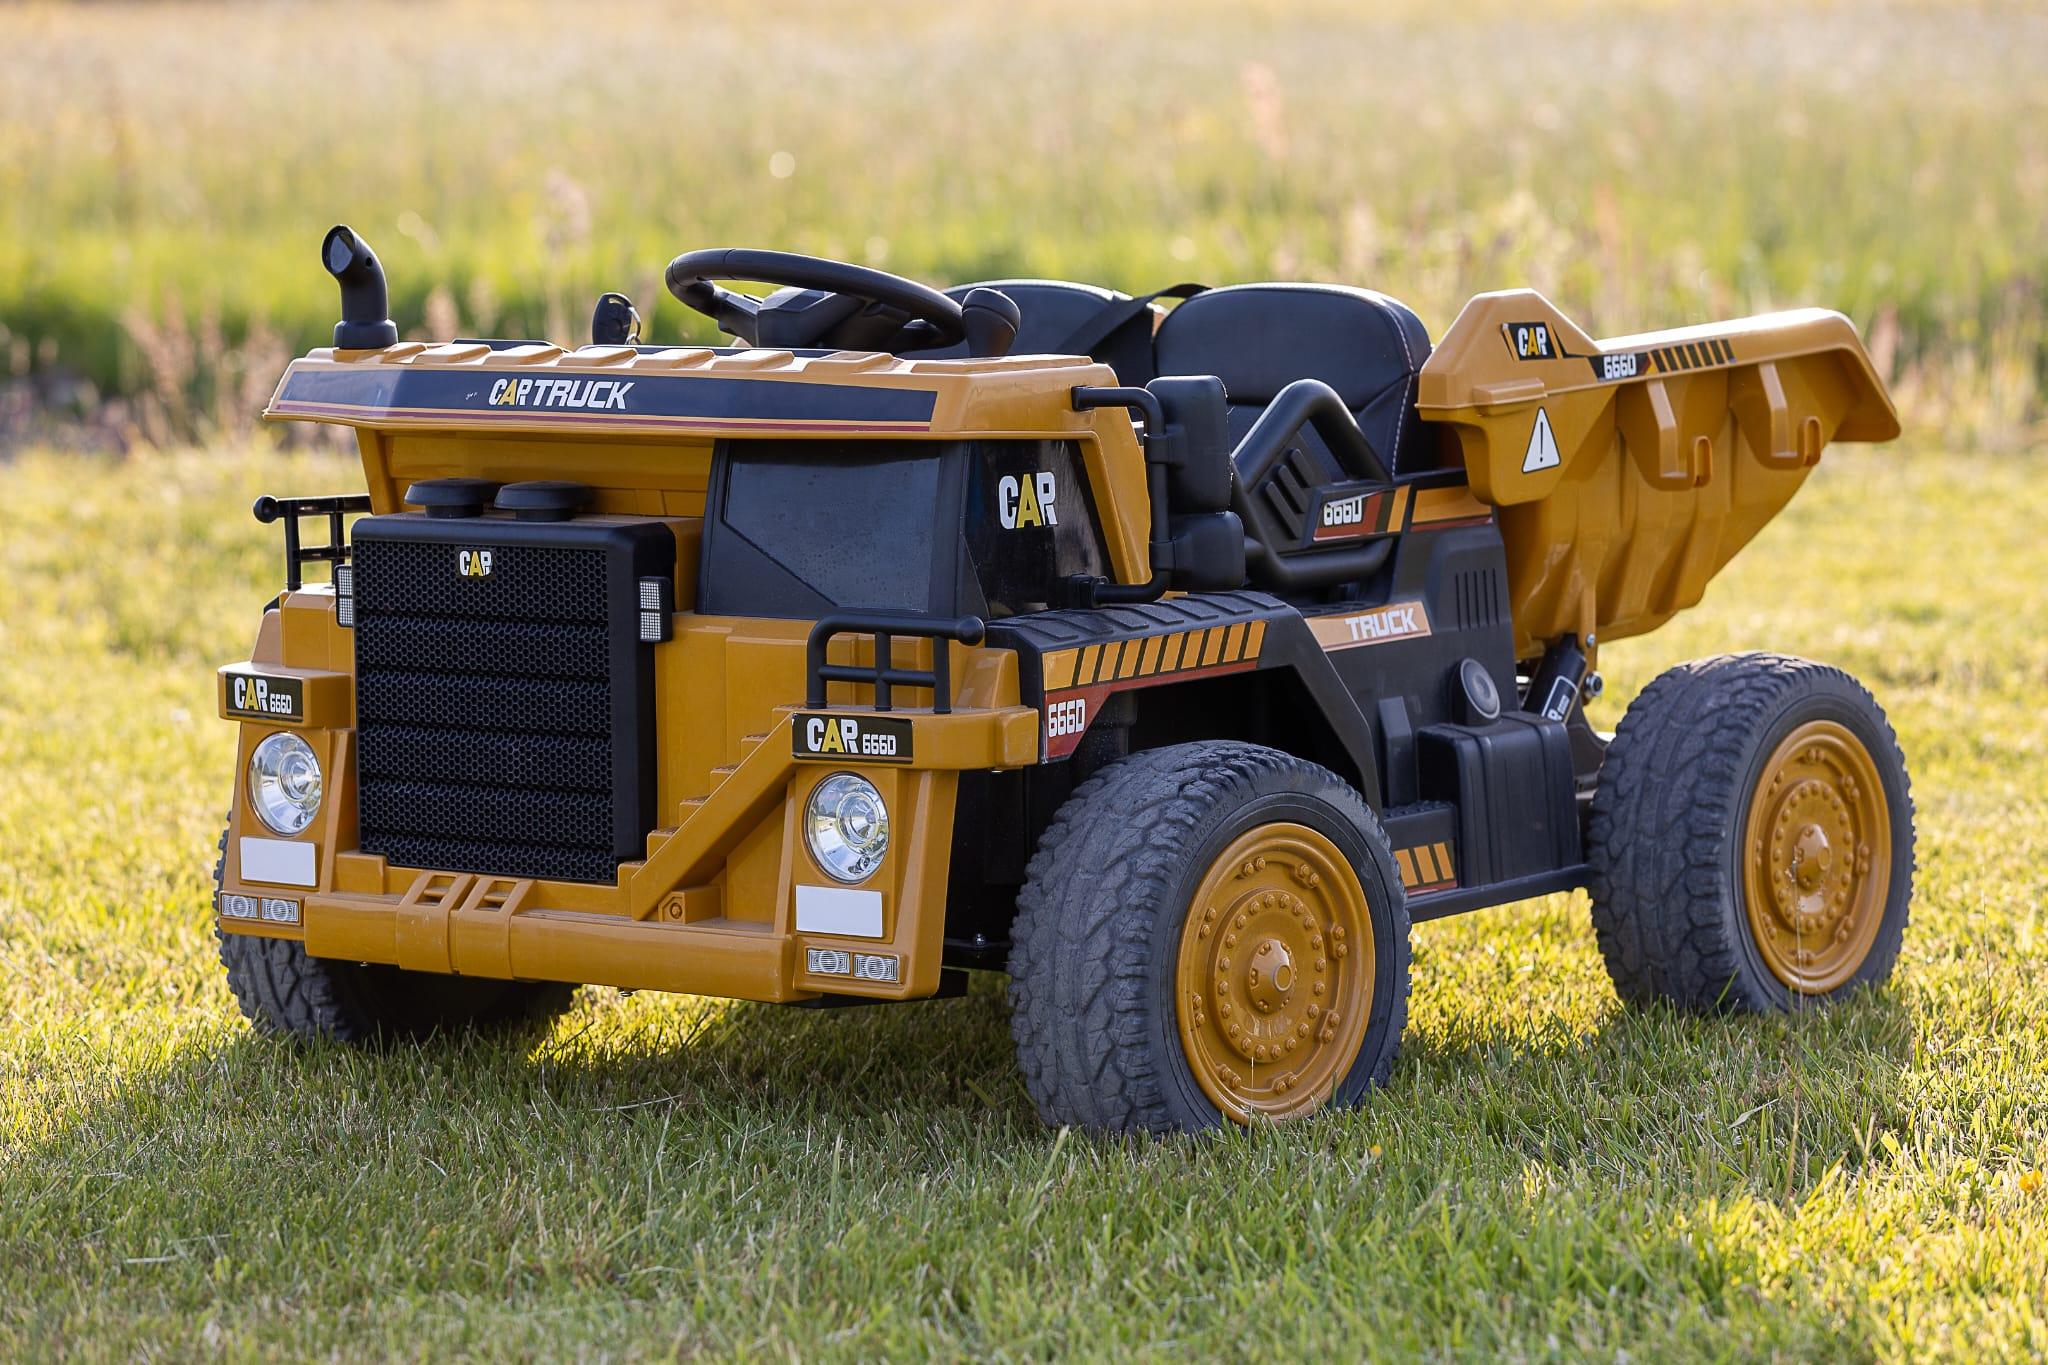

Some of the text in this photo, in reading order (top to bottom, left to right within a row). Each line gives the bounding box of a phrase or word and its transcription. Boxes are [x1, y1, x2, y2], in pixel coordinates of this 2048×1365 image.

[1518, 327, 1547, 357] CAR
[1603, 353, 1637, 379] 666D
[998, 472, 1058, 530] CAR
[459, 550, 492, 577] CAR
[1344, 607, 1418, 641] TRUCK
[234, 677, 292, 714] CAR 666D
[1048, 698, 1086, 738] 666D
[806, 718, 897, 756] CAR 666D
